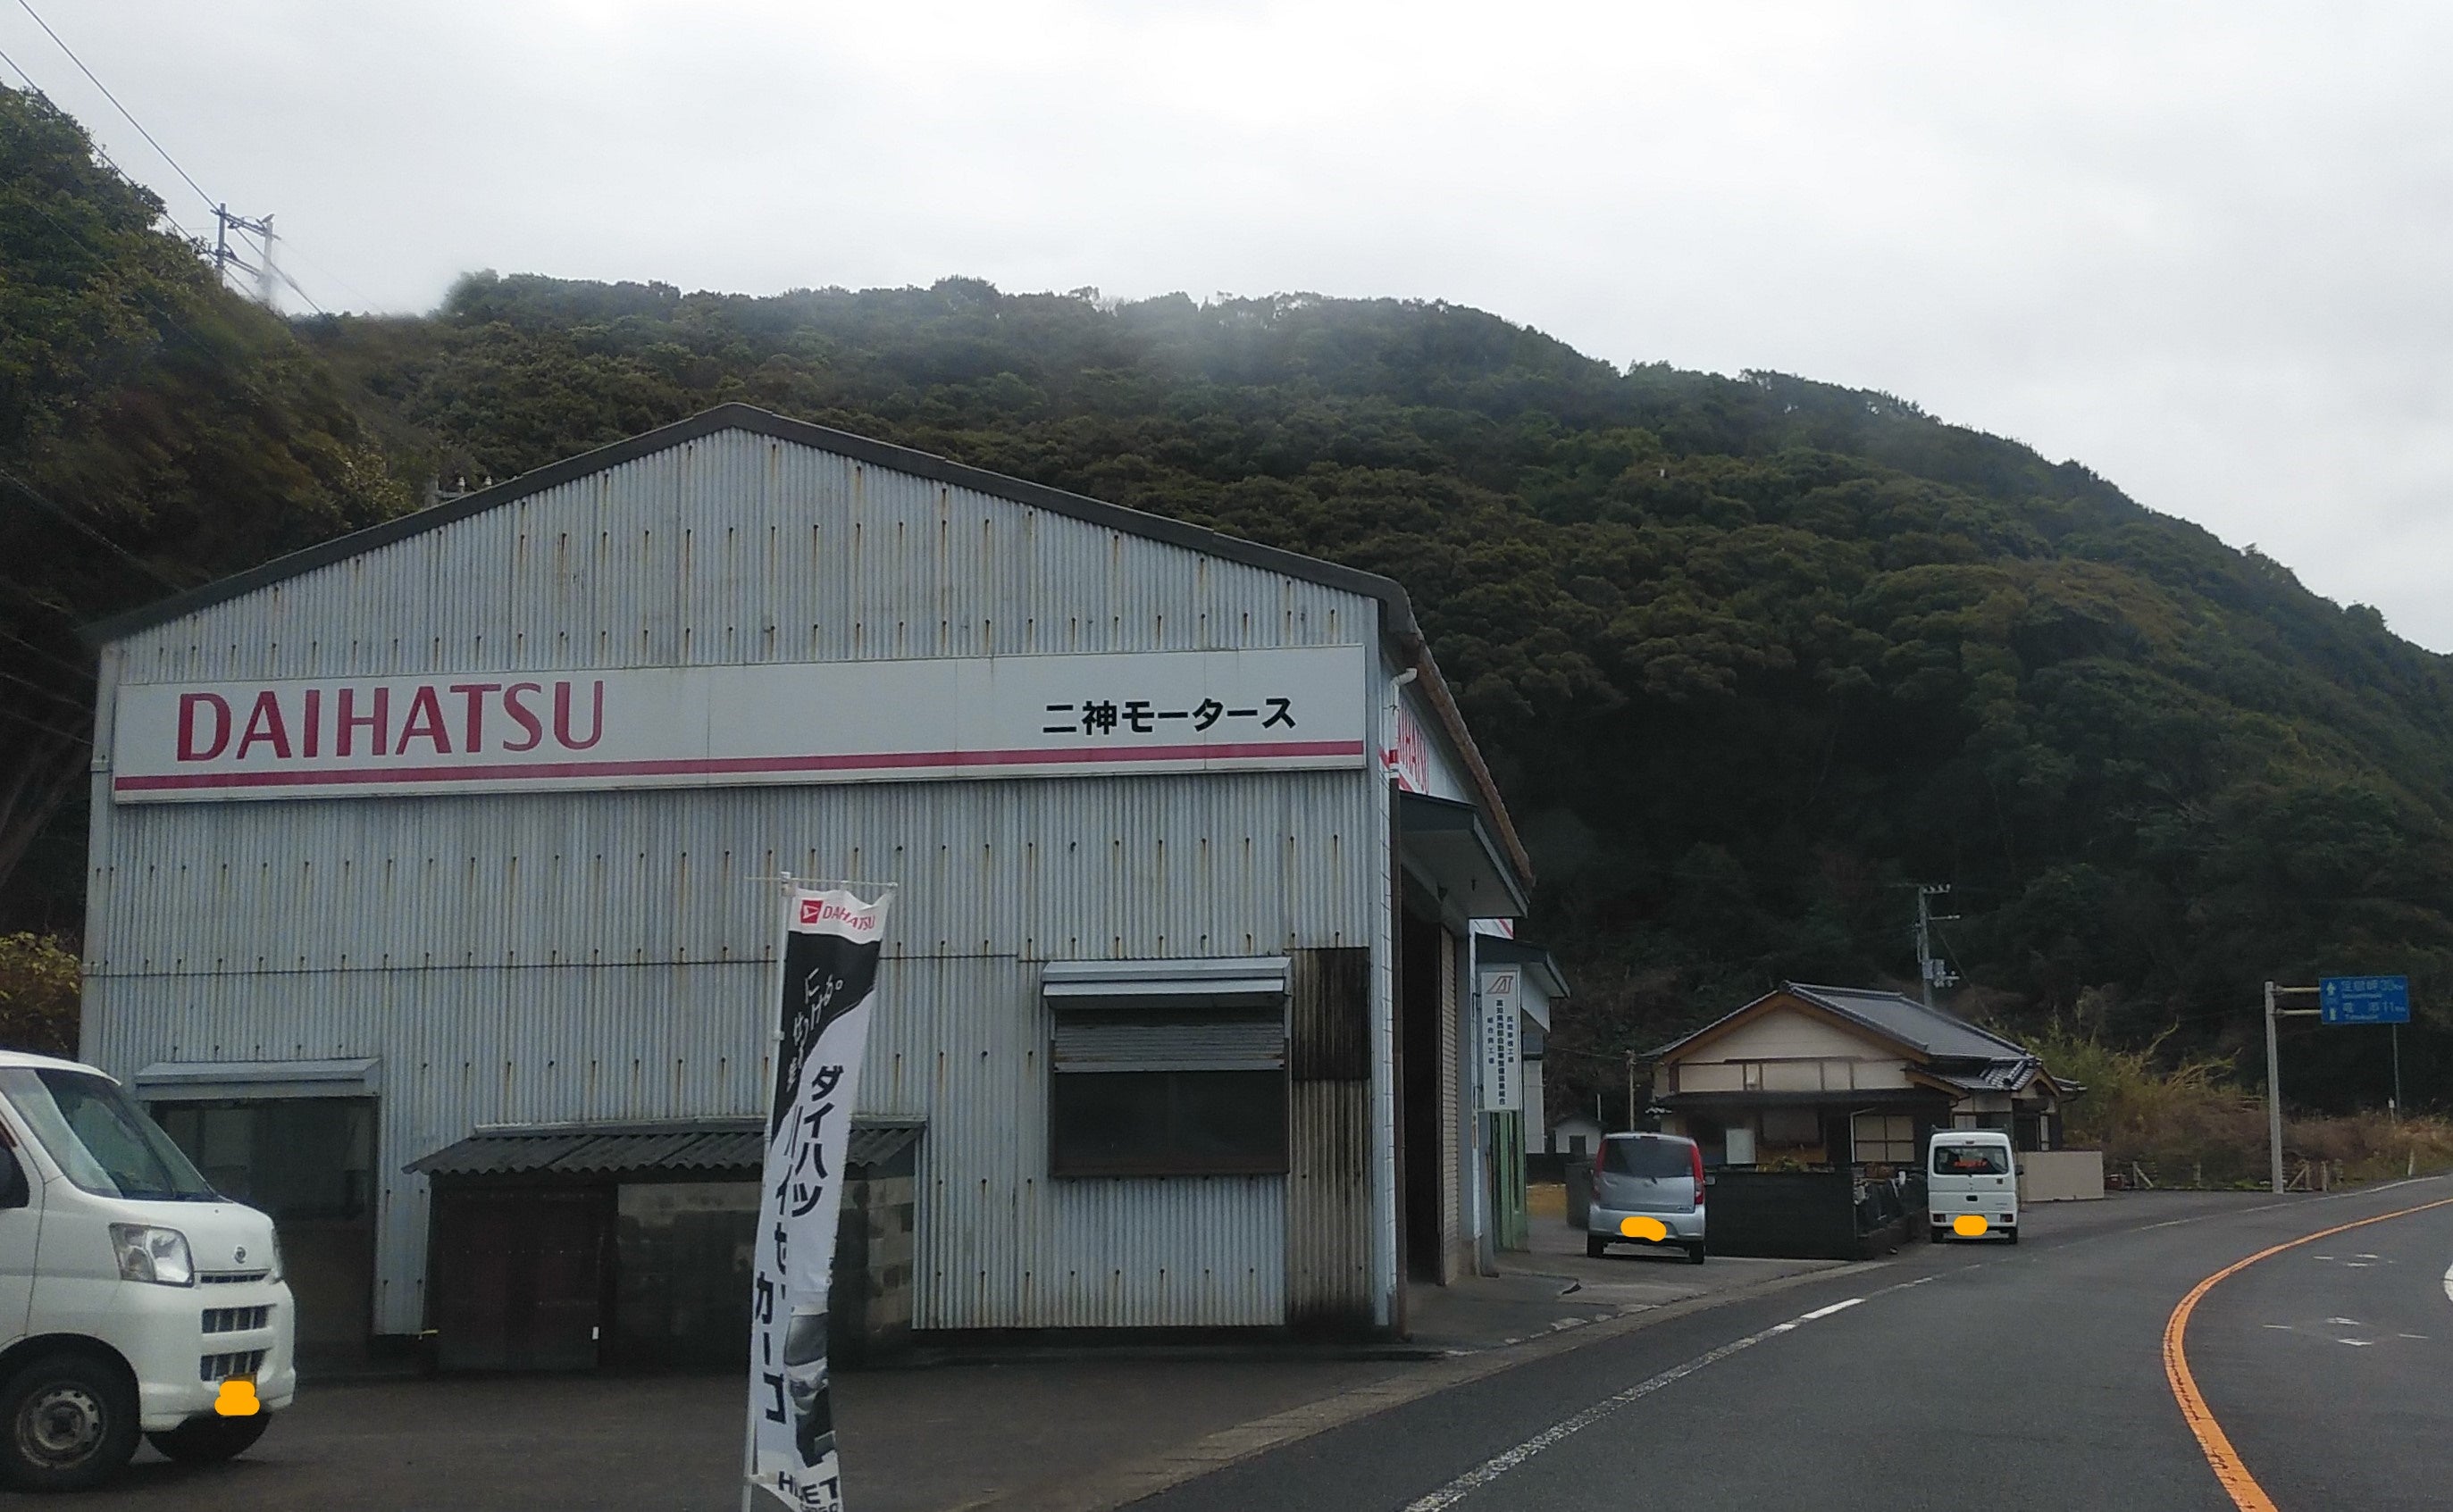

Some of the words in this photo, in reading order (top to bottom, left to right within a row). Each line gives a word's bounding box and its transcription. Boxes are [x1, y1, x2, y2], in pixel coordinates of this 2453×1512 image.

[177, 681, 603, 762] DAIHATSU
[1042, 698, 1296, 735] 二神モータース
[791, 1065, 844, 1217] ダイハツ
